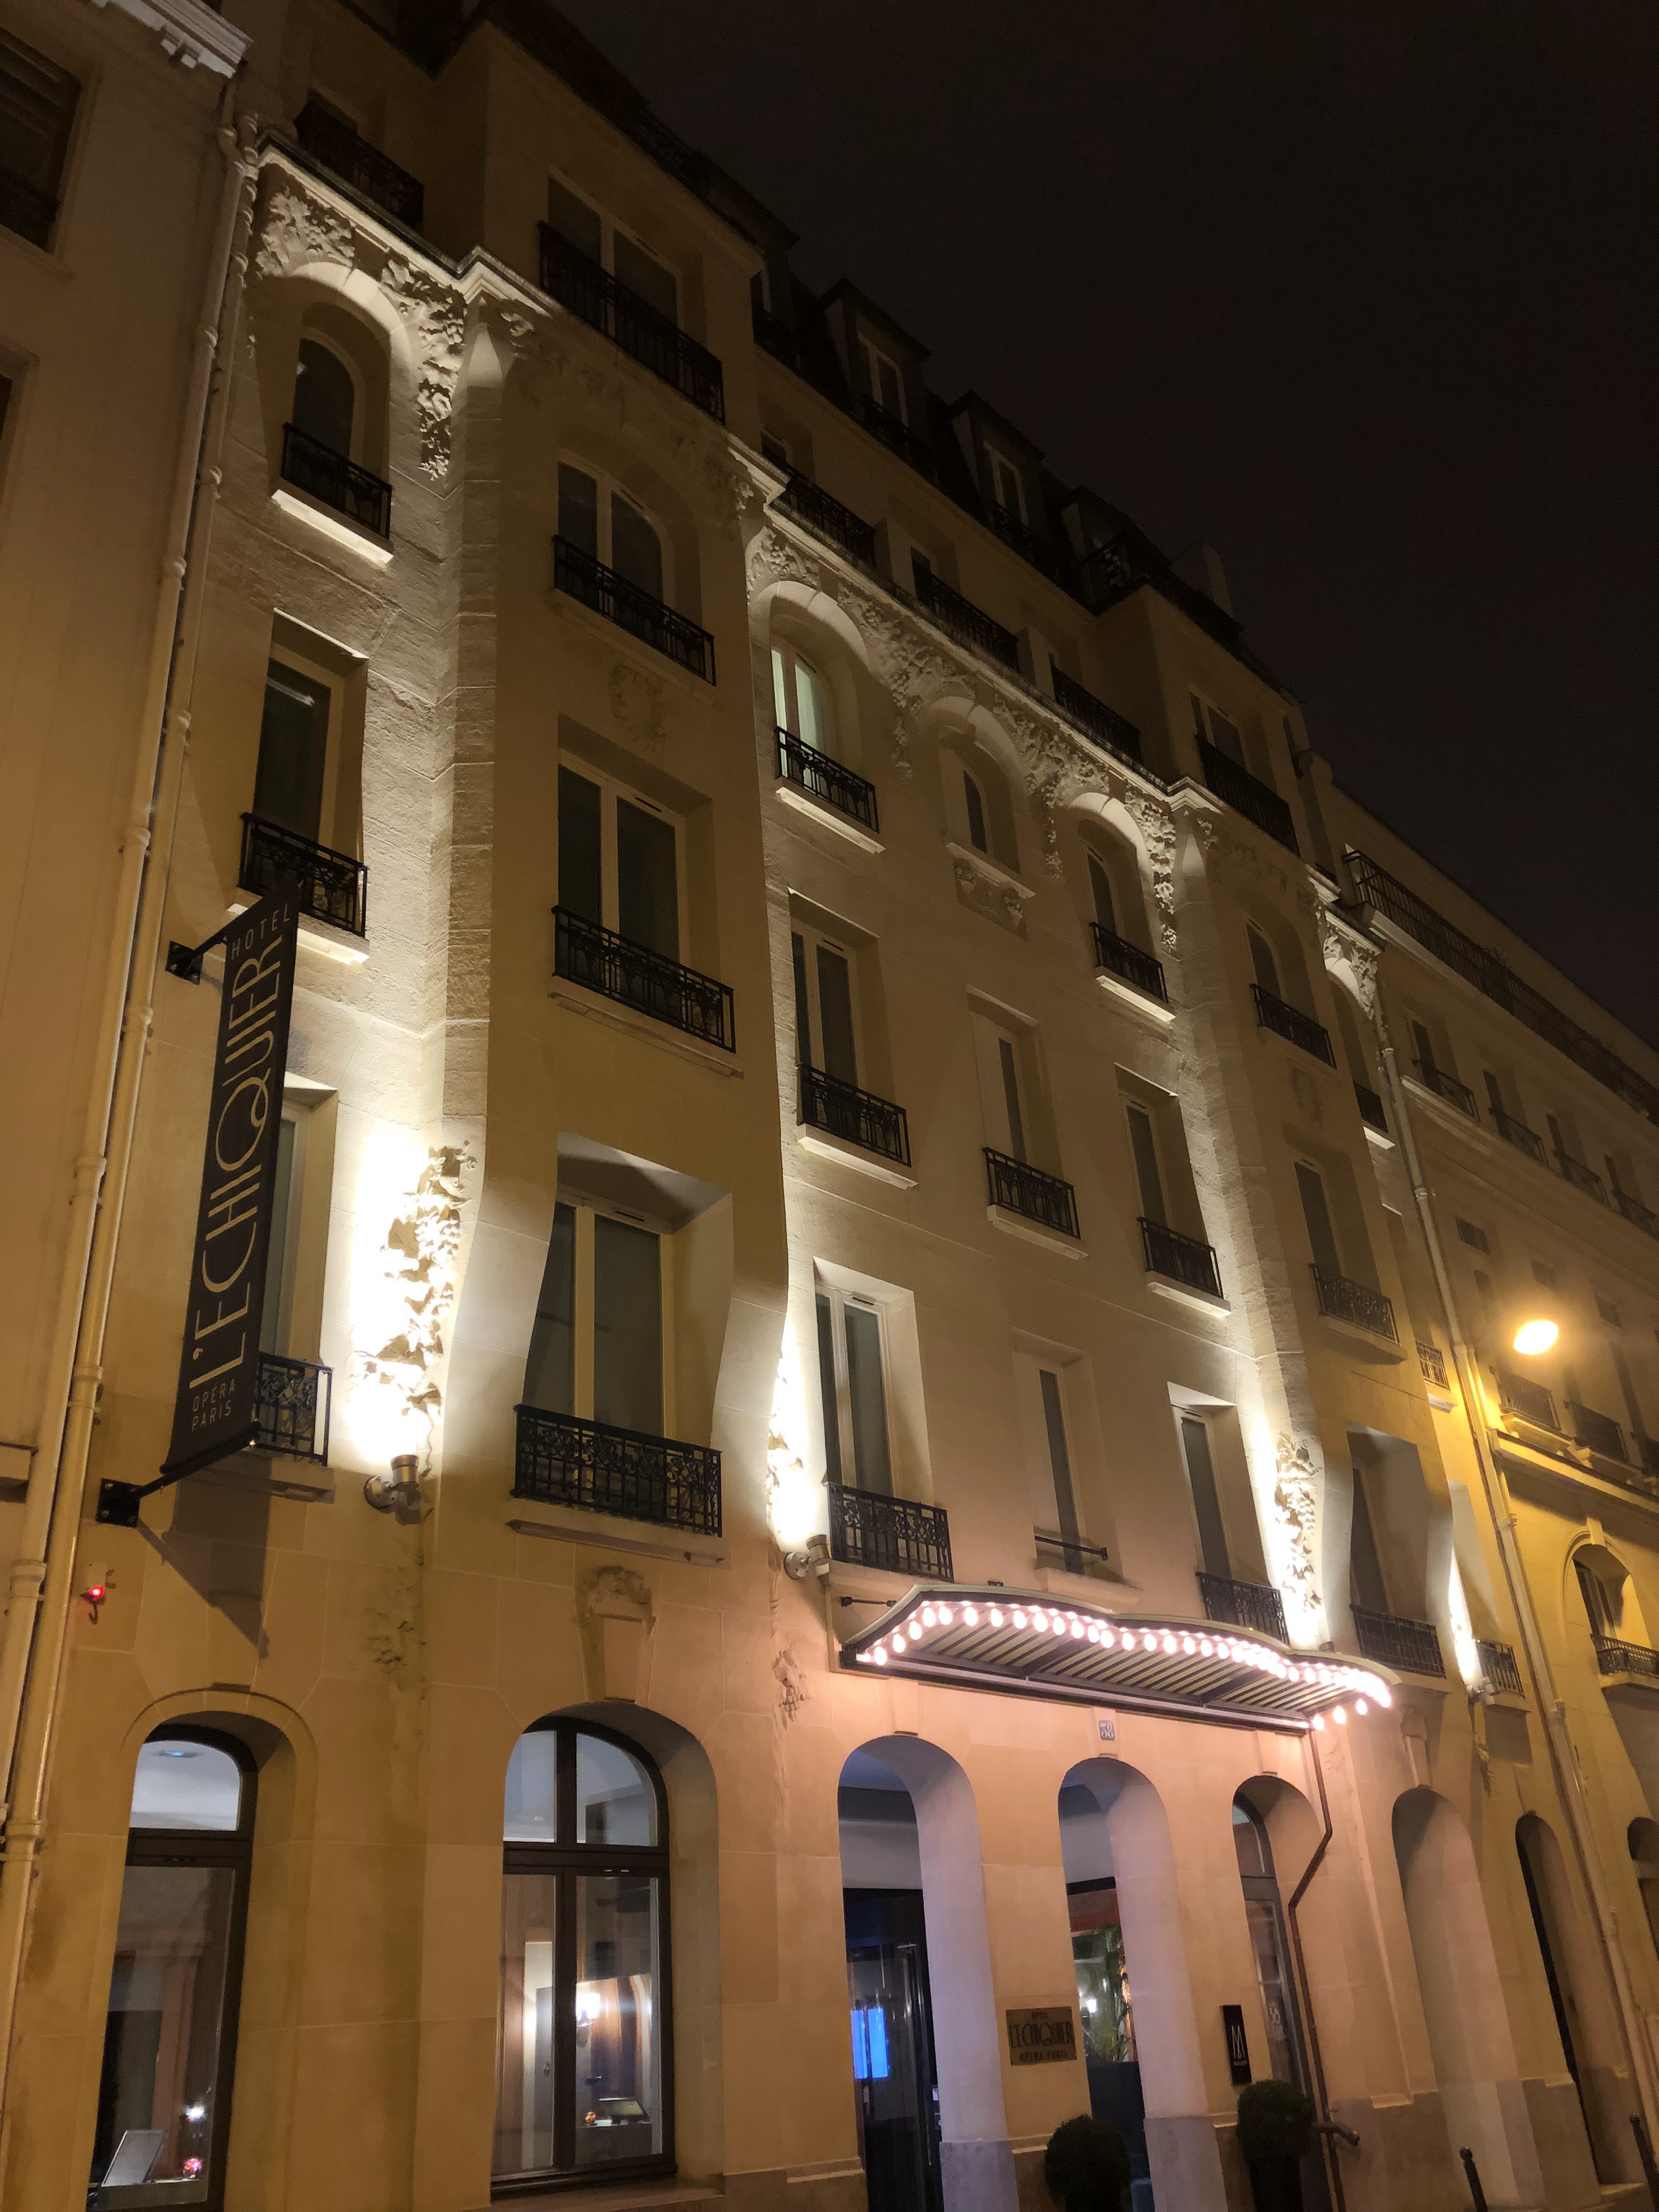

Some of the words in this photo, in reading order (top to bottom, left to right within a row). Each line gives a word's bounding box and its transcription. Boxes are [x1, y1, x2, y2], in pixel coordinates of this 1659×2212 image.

[231, 903, 290, 960] HOTEL
[189, 934, 283, 1389] L'ECHIQUIER
[191, 1399, 231, 1432] PARIS
